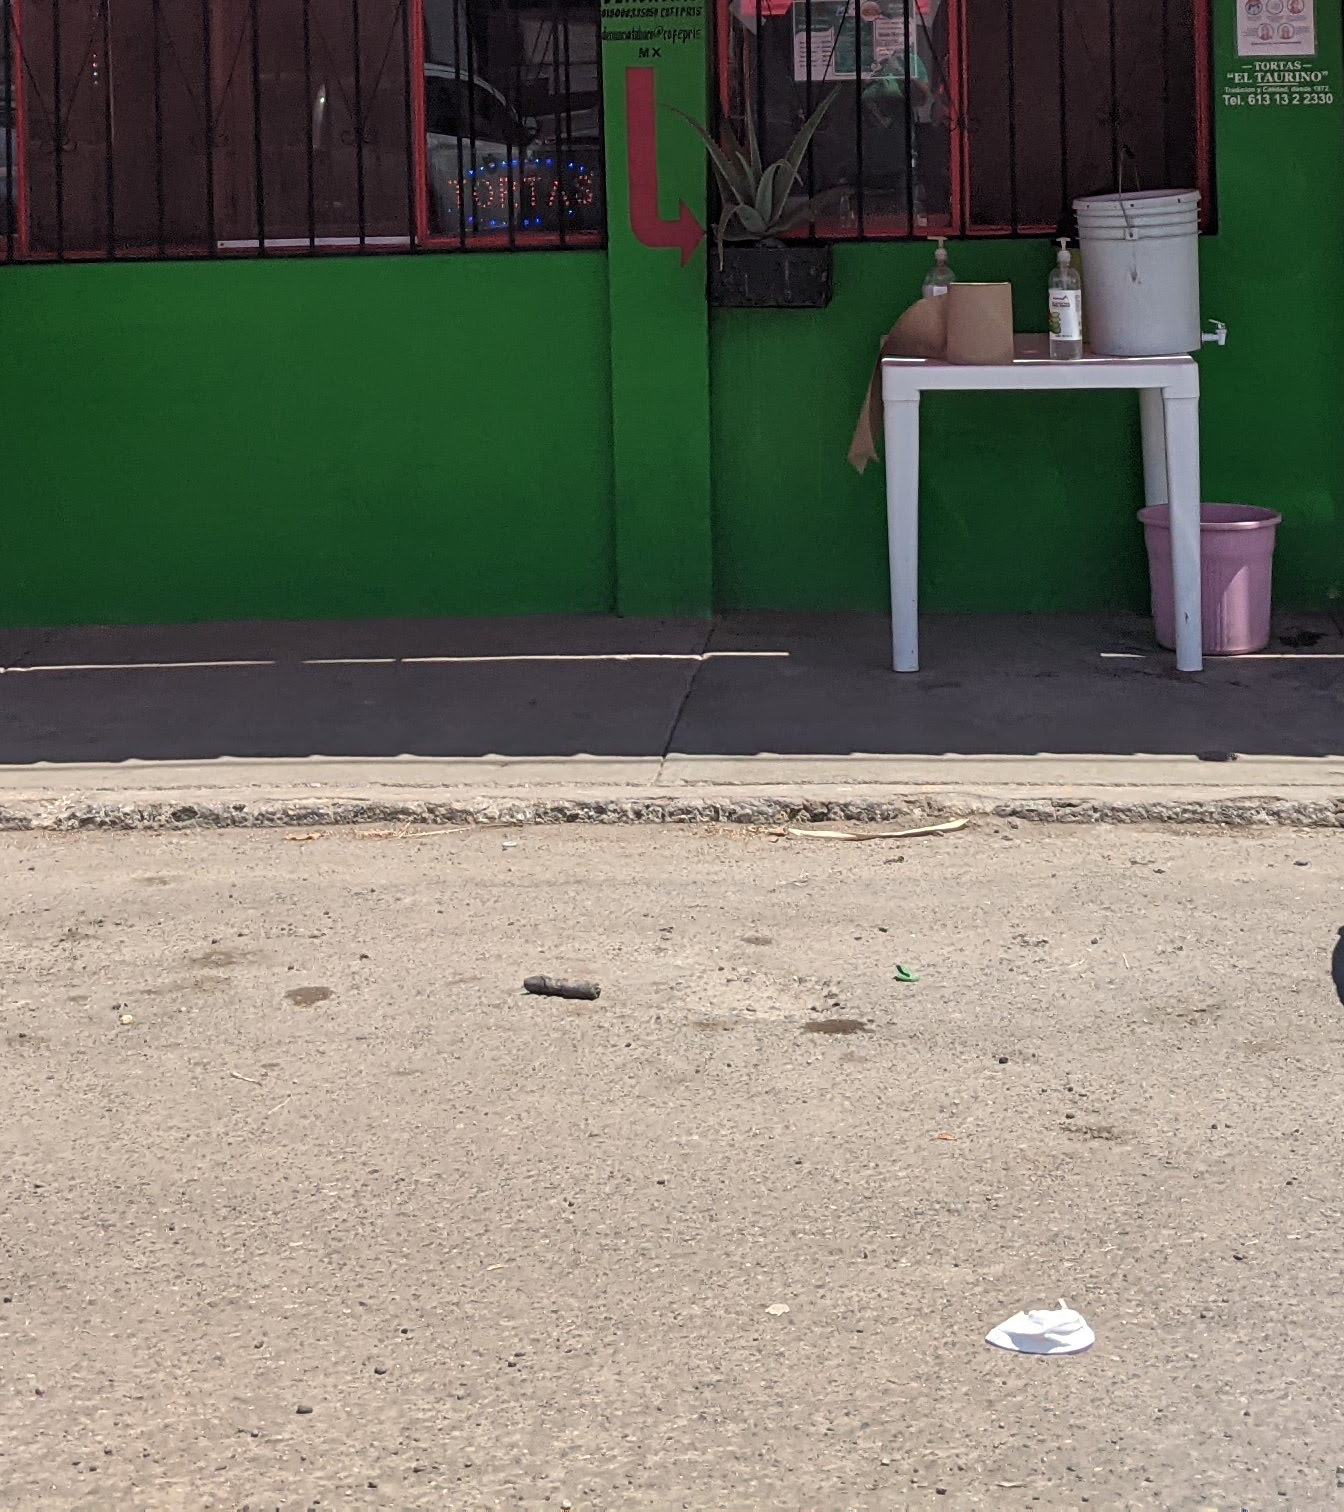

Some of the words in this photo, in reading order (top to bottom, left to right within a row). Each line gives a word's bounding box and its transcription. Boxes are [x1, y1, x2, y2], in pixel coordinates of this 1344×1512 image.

[1254, 60, 1301, 71] TORTAS
[1222, 95, 1245, 105] Tel.
[1248, 94, 1270, 105] 613
[1275, 94, 1289, 104] 13
[1292, 94, 1300, 104] 2
[1303, 93, 1334, 104] 2330
